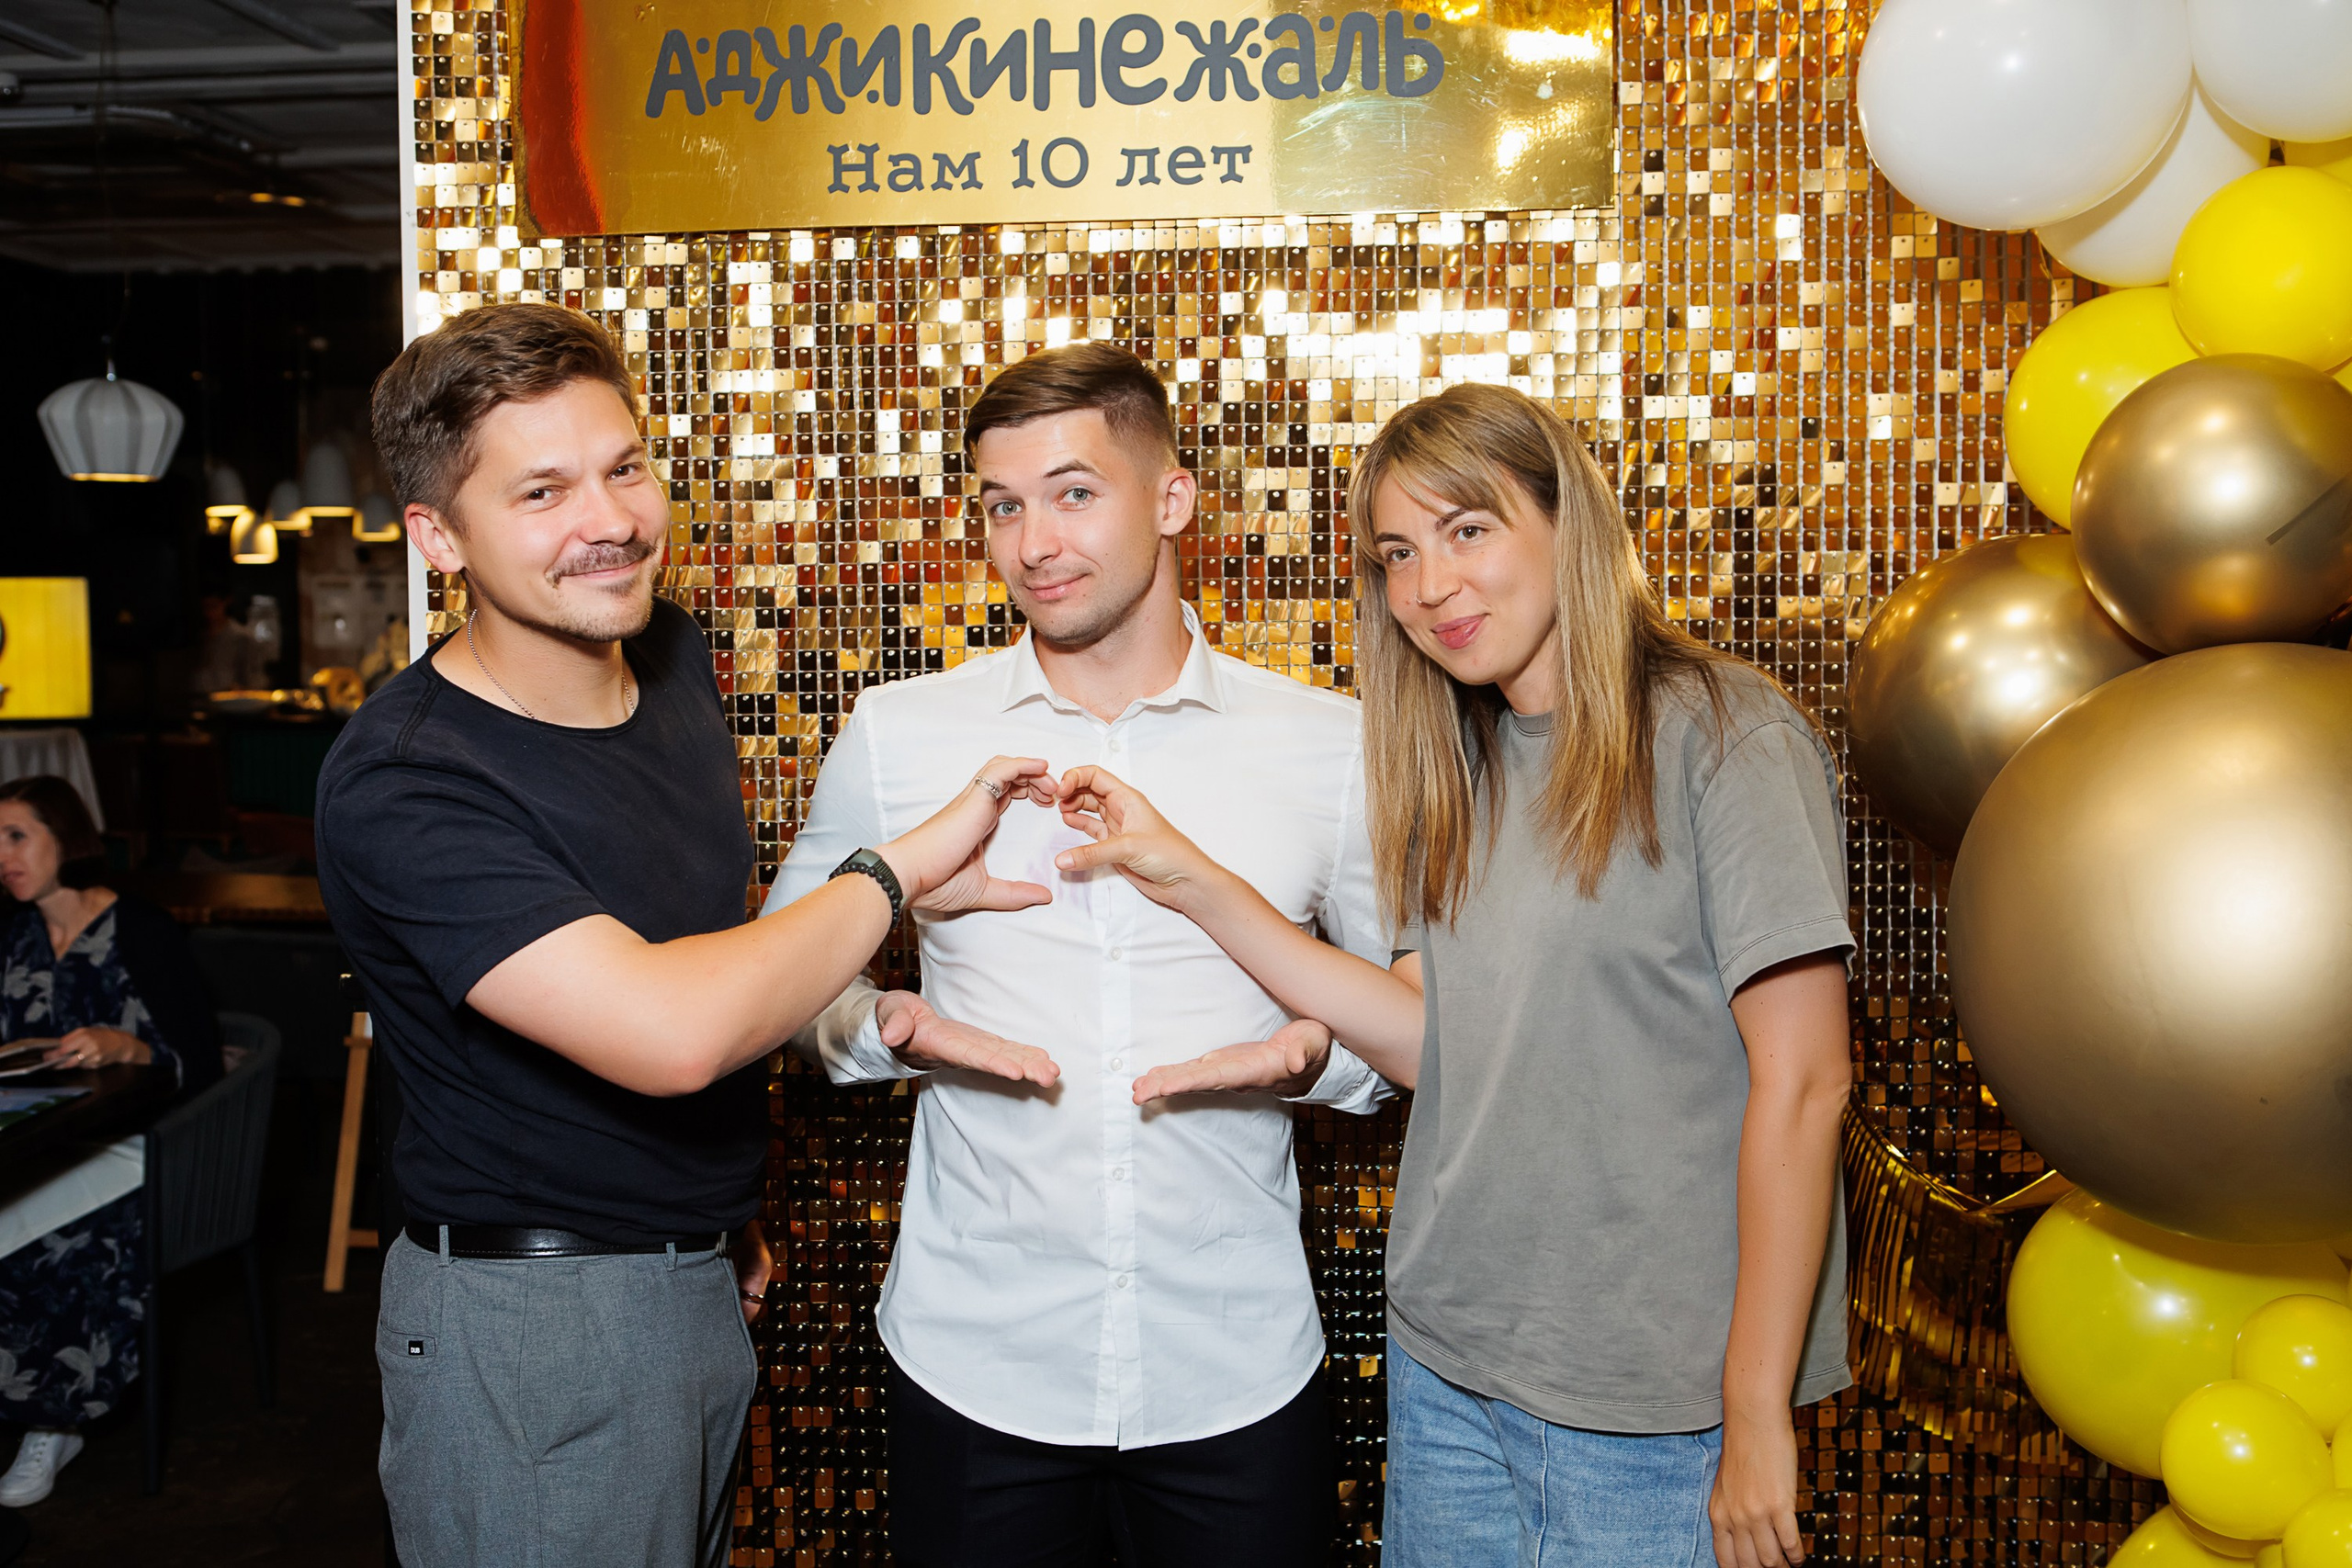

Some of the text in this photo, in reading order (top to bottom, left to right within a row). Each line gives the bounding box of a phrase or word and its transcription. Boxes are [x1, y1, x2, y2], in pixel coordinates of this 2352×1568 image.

[827, 137, 1253, 193] Нам 10 лет
